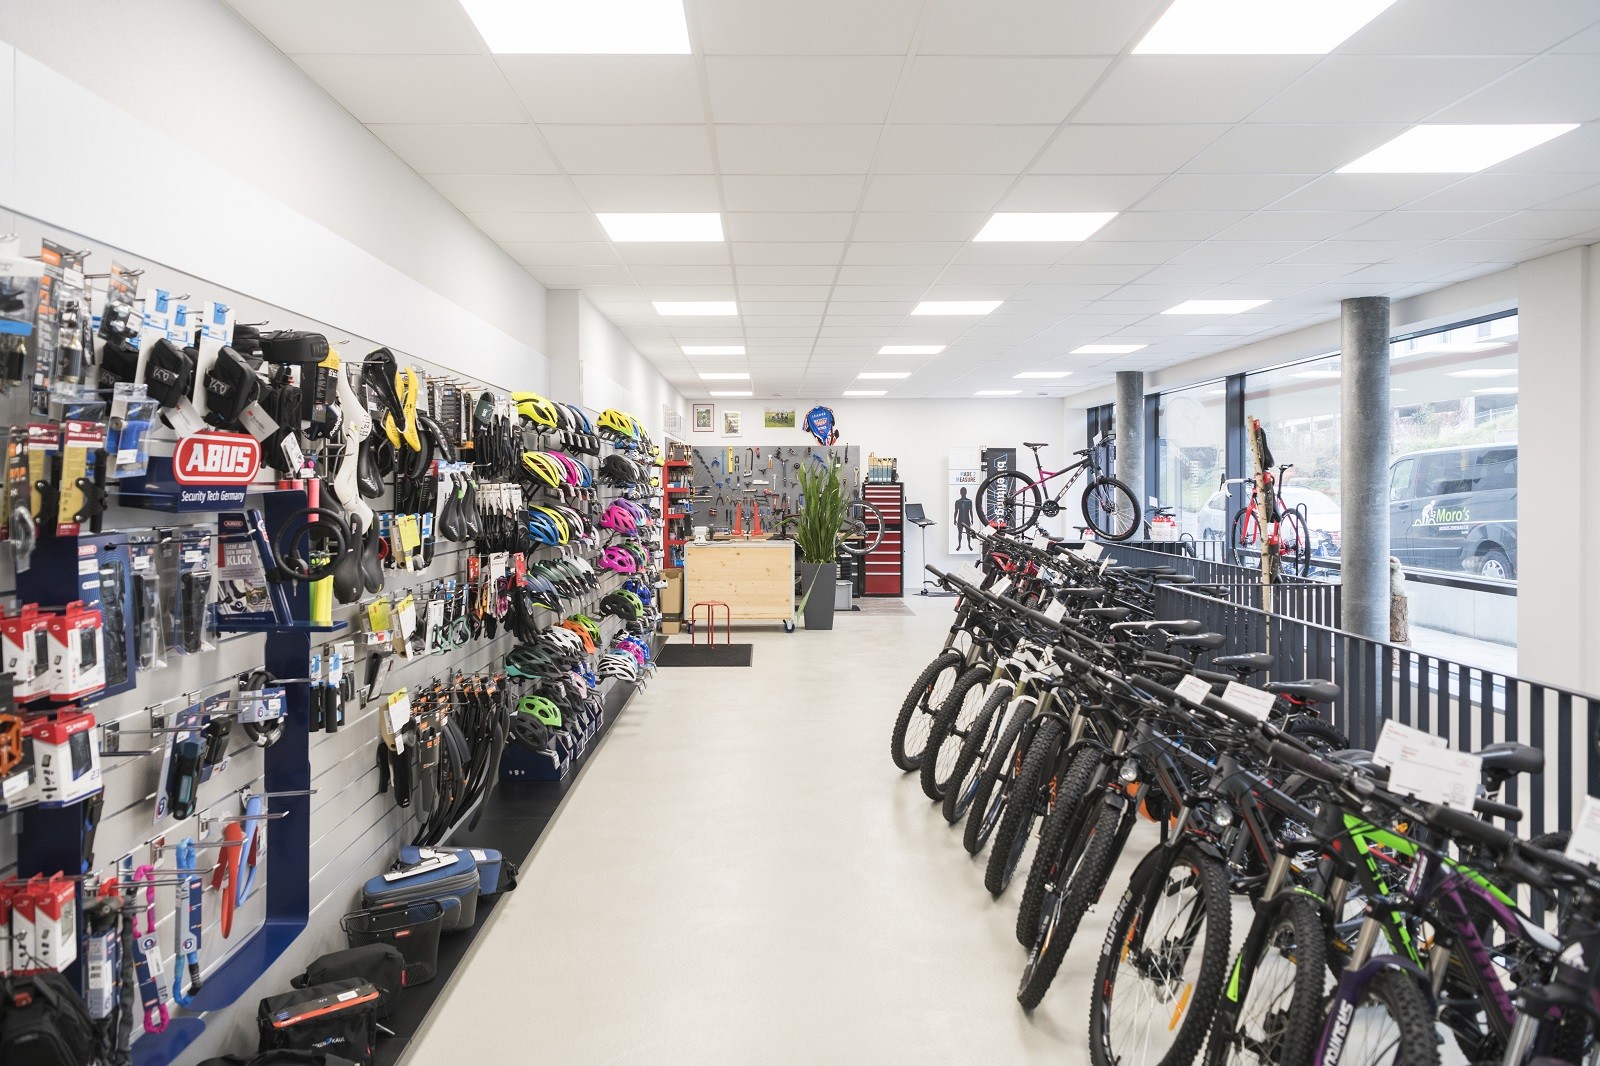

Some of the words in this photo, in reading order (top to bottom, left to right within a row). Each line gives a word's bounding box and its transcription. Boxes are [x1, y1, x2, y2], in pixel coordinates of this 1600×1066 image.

[185, 443, 252, 473] ABUS
[181, 490, 206, 503] Security
[206, 490, 220, 501] Tech
[220, 490, 245, 503] Germany
[1436, 506, 1470, 522] Moro's
[226, 554, 252, 566] KLICK
